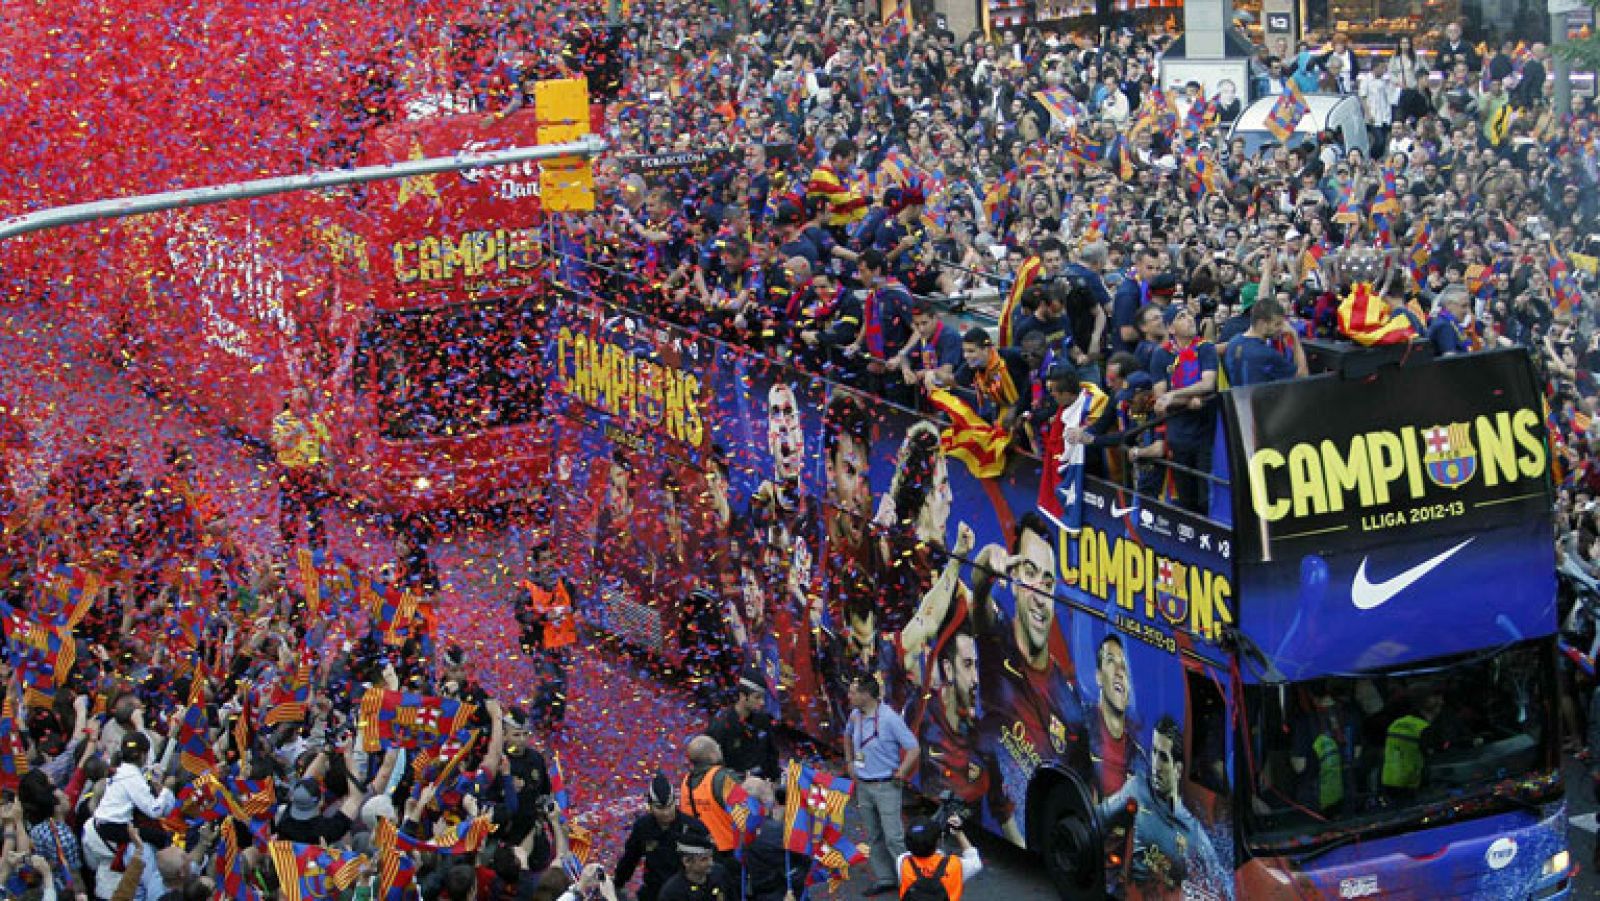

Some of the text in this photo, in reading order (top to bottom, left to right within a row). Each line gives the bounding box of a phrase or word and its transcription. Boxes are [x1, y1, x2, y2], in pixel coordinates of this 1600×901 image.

[1250, 408, 1546, 522] CAMPIONS
[1362, 501, 1465, 531] LLIGA 2012-13
[1059, 526, 1232, 641] CAMPIONS
